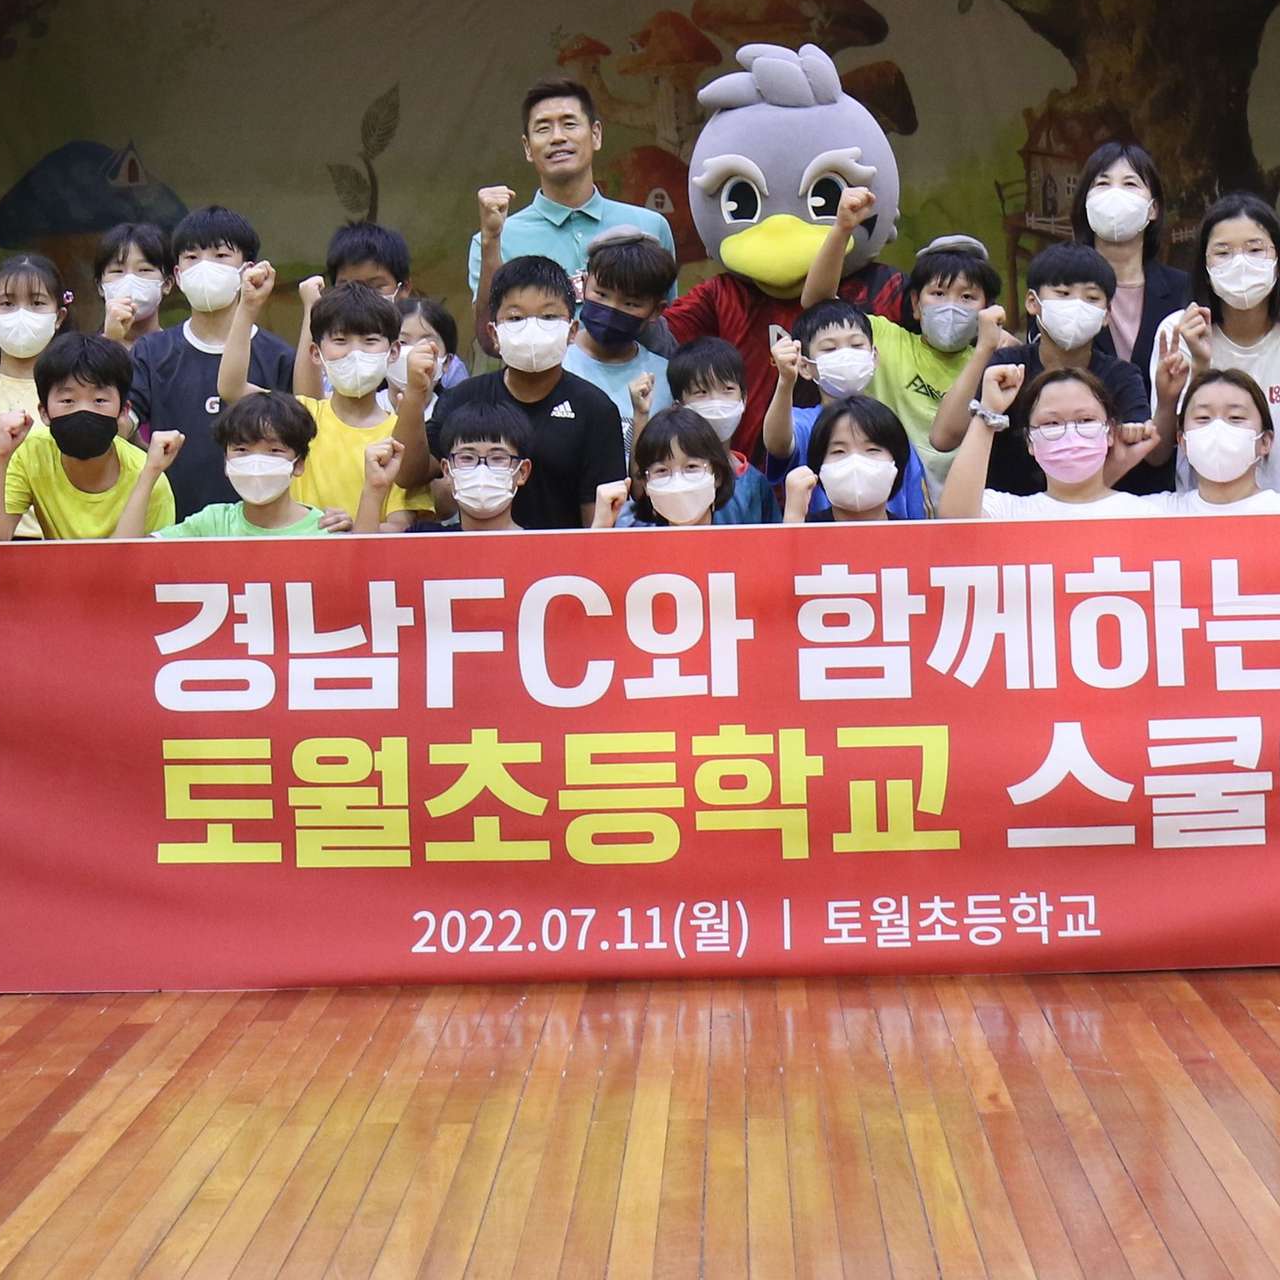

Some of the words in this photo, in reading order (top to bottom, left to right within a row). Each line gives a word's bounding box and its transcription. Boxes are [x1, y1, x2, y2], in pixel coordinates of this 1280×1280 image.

[154, 572, 754, 712] 경남FC와
[157, 724, 961, 868] 토월초등학교
[410, 898, 750, 960] 2022.07.11(월)
[822, 891, 1102, 948] 토월초등학교
